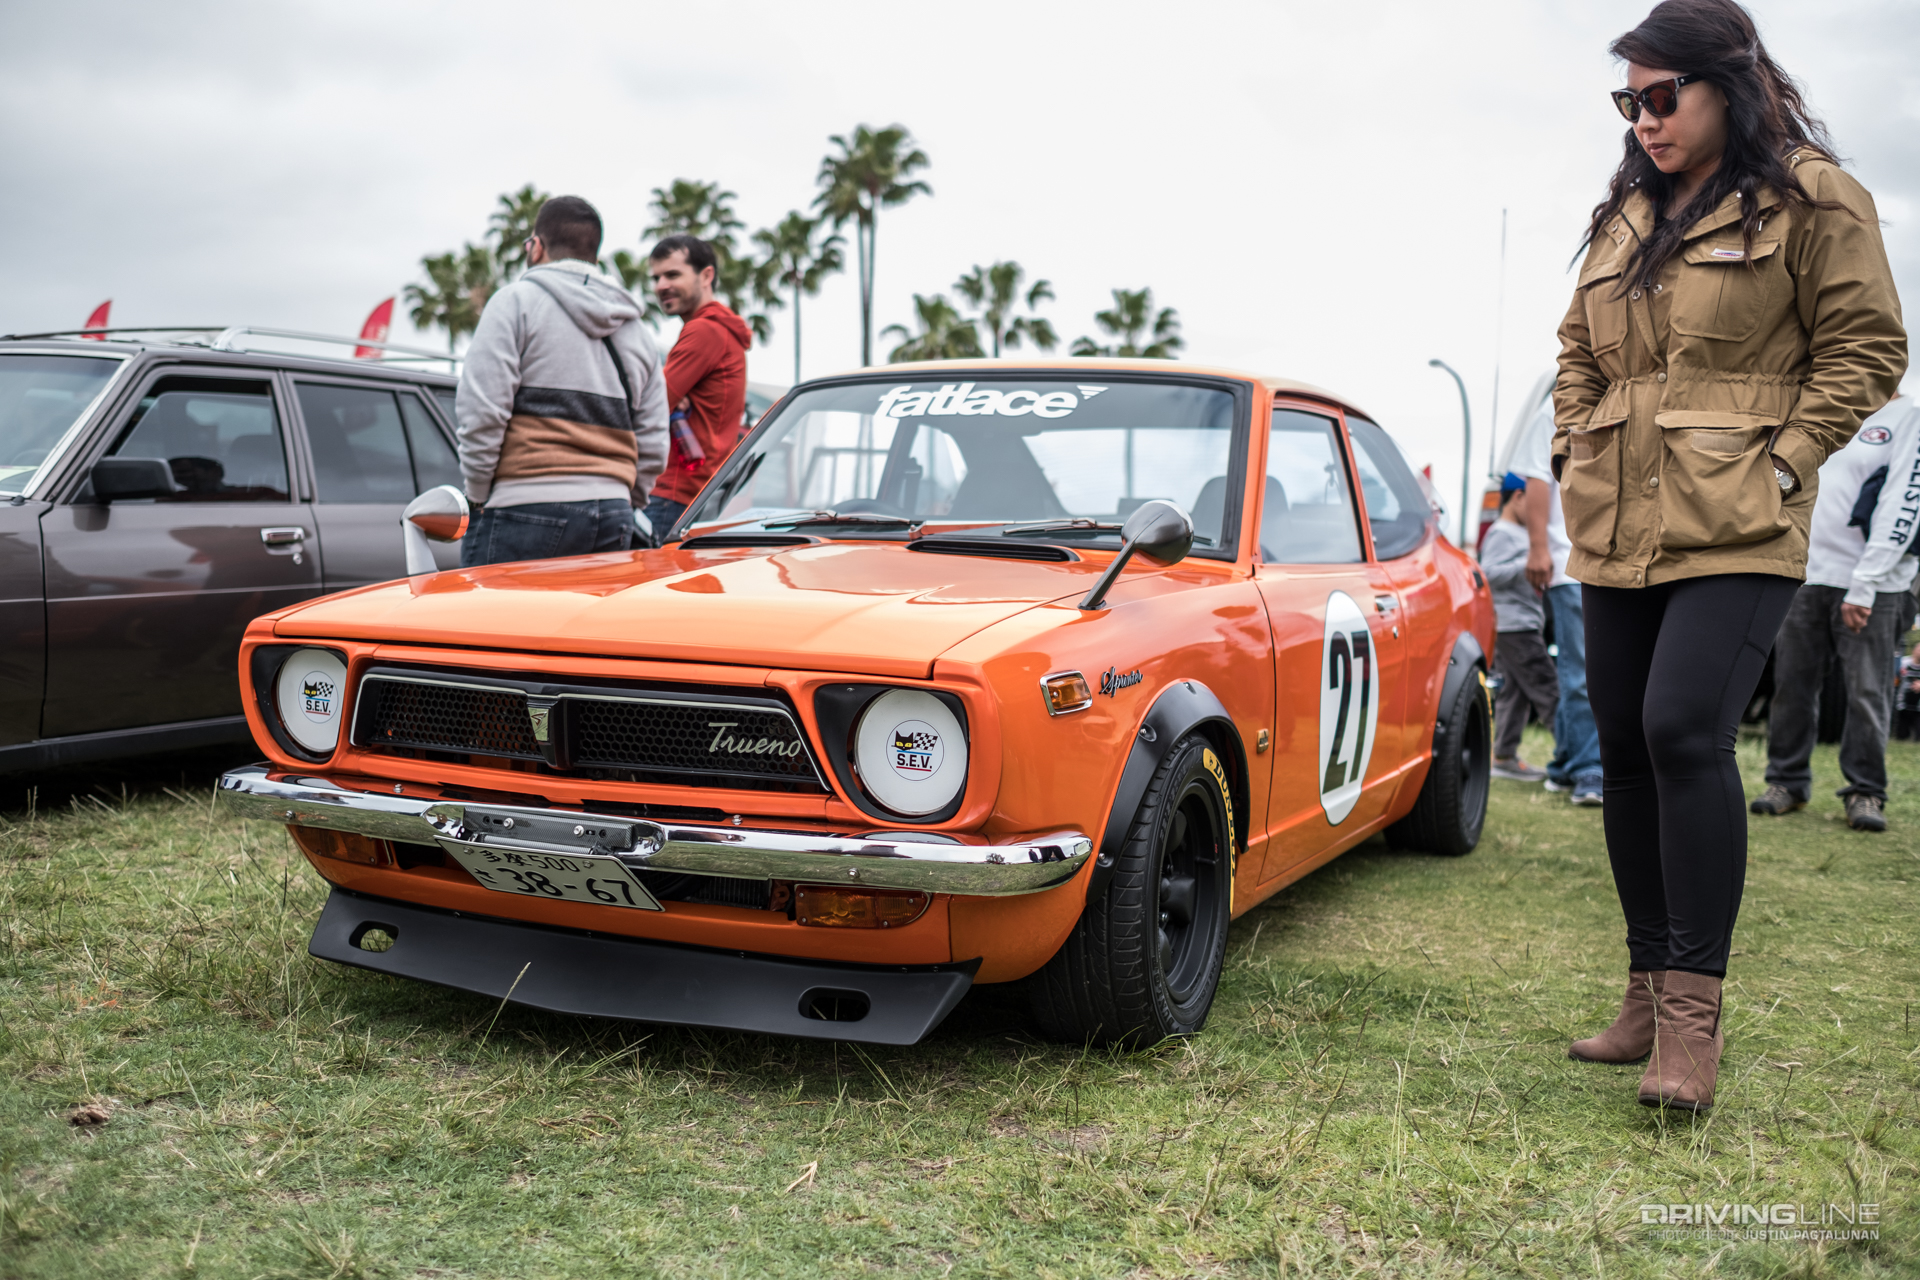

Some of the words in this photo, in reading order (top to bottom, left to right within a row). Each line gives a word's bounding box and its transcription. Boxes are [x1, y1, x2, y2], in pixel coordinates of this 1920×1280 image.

[874, 382, 1079, 420] fatlace
[1098, 666, 1144, 699] Sprinter
[305, 699, 331, 713] S.E.V.
[1322, 629, 1370, 795] 27
[708, 722, 801, 757] Trueno
[897, 753, 932, 769] S.E.V.
[496, 867, 637, 906] 38-67
